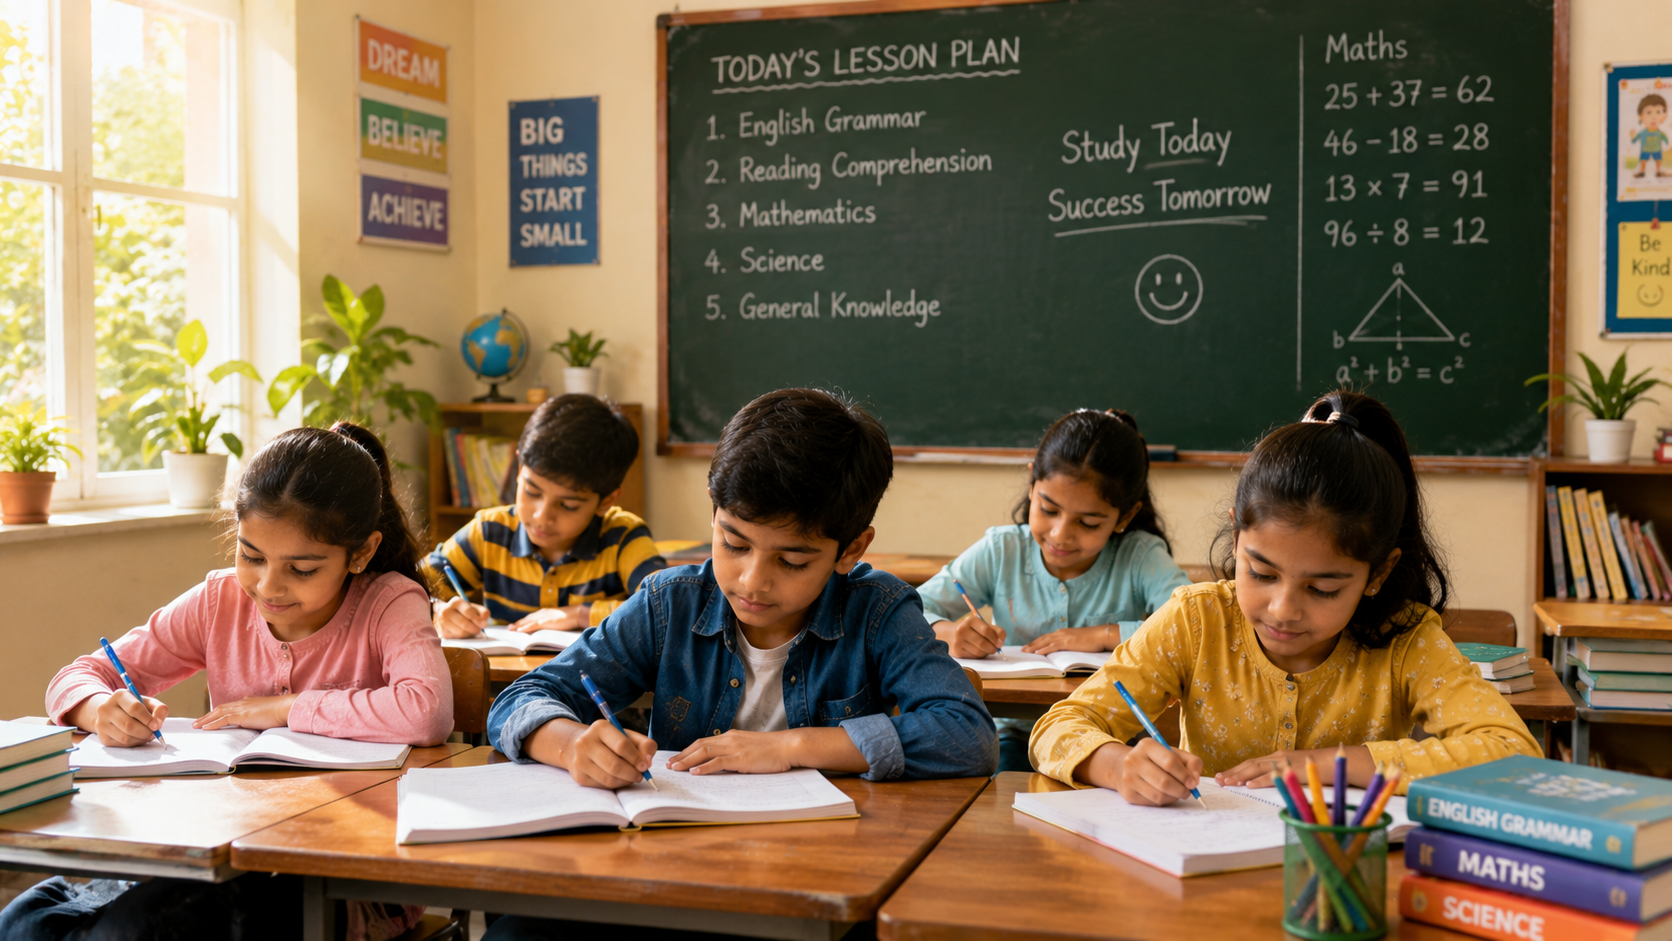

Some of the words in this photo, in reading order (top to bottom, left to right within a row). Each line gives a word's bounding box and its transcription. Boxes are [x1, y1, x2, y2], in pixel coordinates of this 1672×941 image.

[367, 38, 440, 88] DREAM
[711, 48, 822, 84] TODAY'S
[833, 42, 938, 76] LESSON
[950, 36, 1020, 68] PLAN
[1325, 29, 1408, 64] Maths
[1324, 82, 1358, 111] 25
[1366, 86, 1382, 107] +
[1388, 79, 1423, 108] 37
[1431, 86, 1448, 99] =
[1456, 75, 1495, 104] 62
[367, 114, 443, 159] BELIEVE
[520, 116, 564, 145] BIG
[706, 115, 726, 141] 1.
[739, 106, 815, 147] English
[824, 105, 927, 133] Grammar
[1323, 128, 1358, 157] 46
[1388, 125, 1419, 154] 18
[1428, 133, 1444, 146] =
[1453, 122, 1490, 151] 28
[1061, 124, 1141, 174] Study
[1151, 117, 1232, 167] Today
[519, 152, 588, 179] THINGS
[704, 159, 727, 184] 2.
[739, 153, 822, 190] Reading
[831, 147, 993, 187] Comprehension
[520, 186, 586, 213] START
[1047, 188, 1145, 222] Success
[1153, 178, 1272, 212] Tomorrow
[1325, 174, 1357, 202] 13
[1392, 172, 1411, 200] 7
[1423, 180, 1440, 192] =
[1451, 169, 1488, 198] 91
[367, 191, 445, 231] ACHIEVE
[705, 203, 727, 230] 3.
[739, 198, 877, 228] Mathematics
[520, 222, 588, 248] SMALL
[1323, 219, 1357, 247] 96
[1367, 223, 1384, 244] ÷
[1393, 218, 1410, 246] 8
[1423, 226, 1440, 239] =
[1452, 217, 1489, 244] 12
[1640, 233, 1661, 252] Be
[704, 248, 727, 275] 4.
[739, 246, 825, 273] Science
[1391, 262, 1405, 276] a
[1632, 257, 1670, 276] Kind
[705, 294, 727, 321] 5.
[739, 292, 820, 320] General
[831, 288, 941, 328] Knowledge
[1332, 330, 1346, 349] b
[1363, 363, 1379, 382] +
[1416, 367, 1431, 379] =
[1428, 797, 1498, 830] ENGLISH
[1501, 813, 1593, 850] GRAMMAR
[1458, 850, 1546, 892] MATHS
[1443, 896, 1545, 941] SCIENCE
